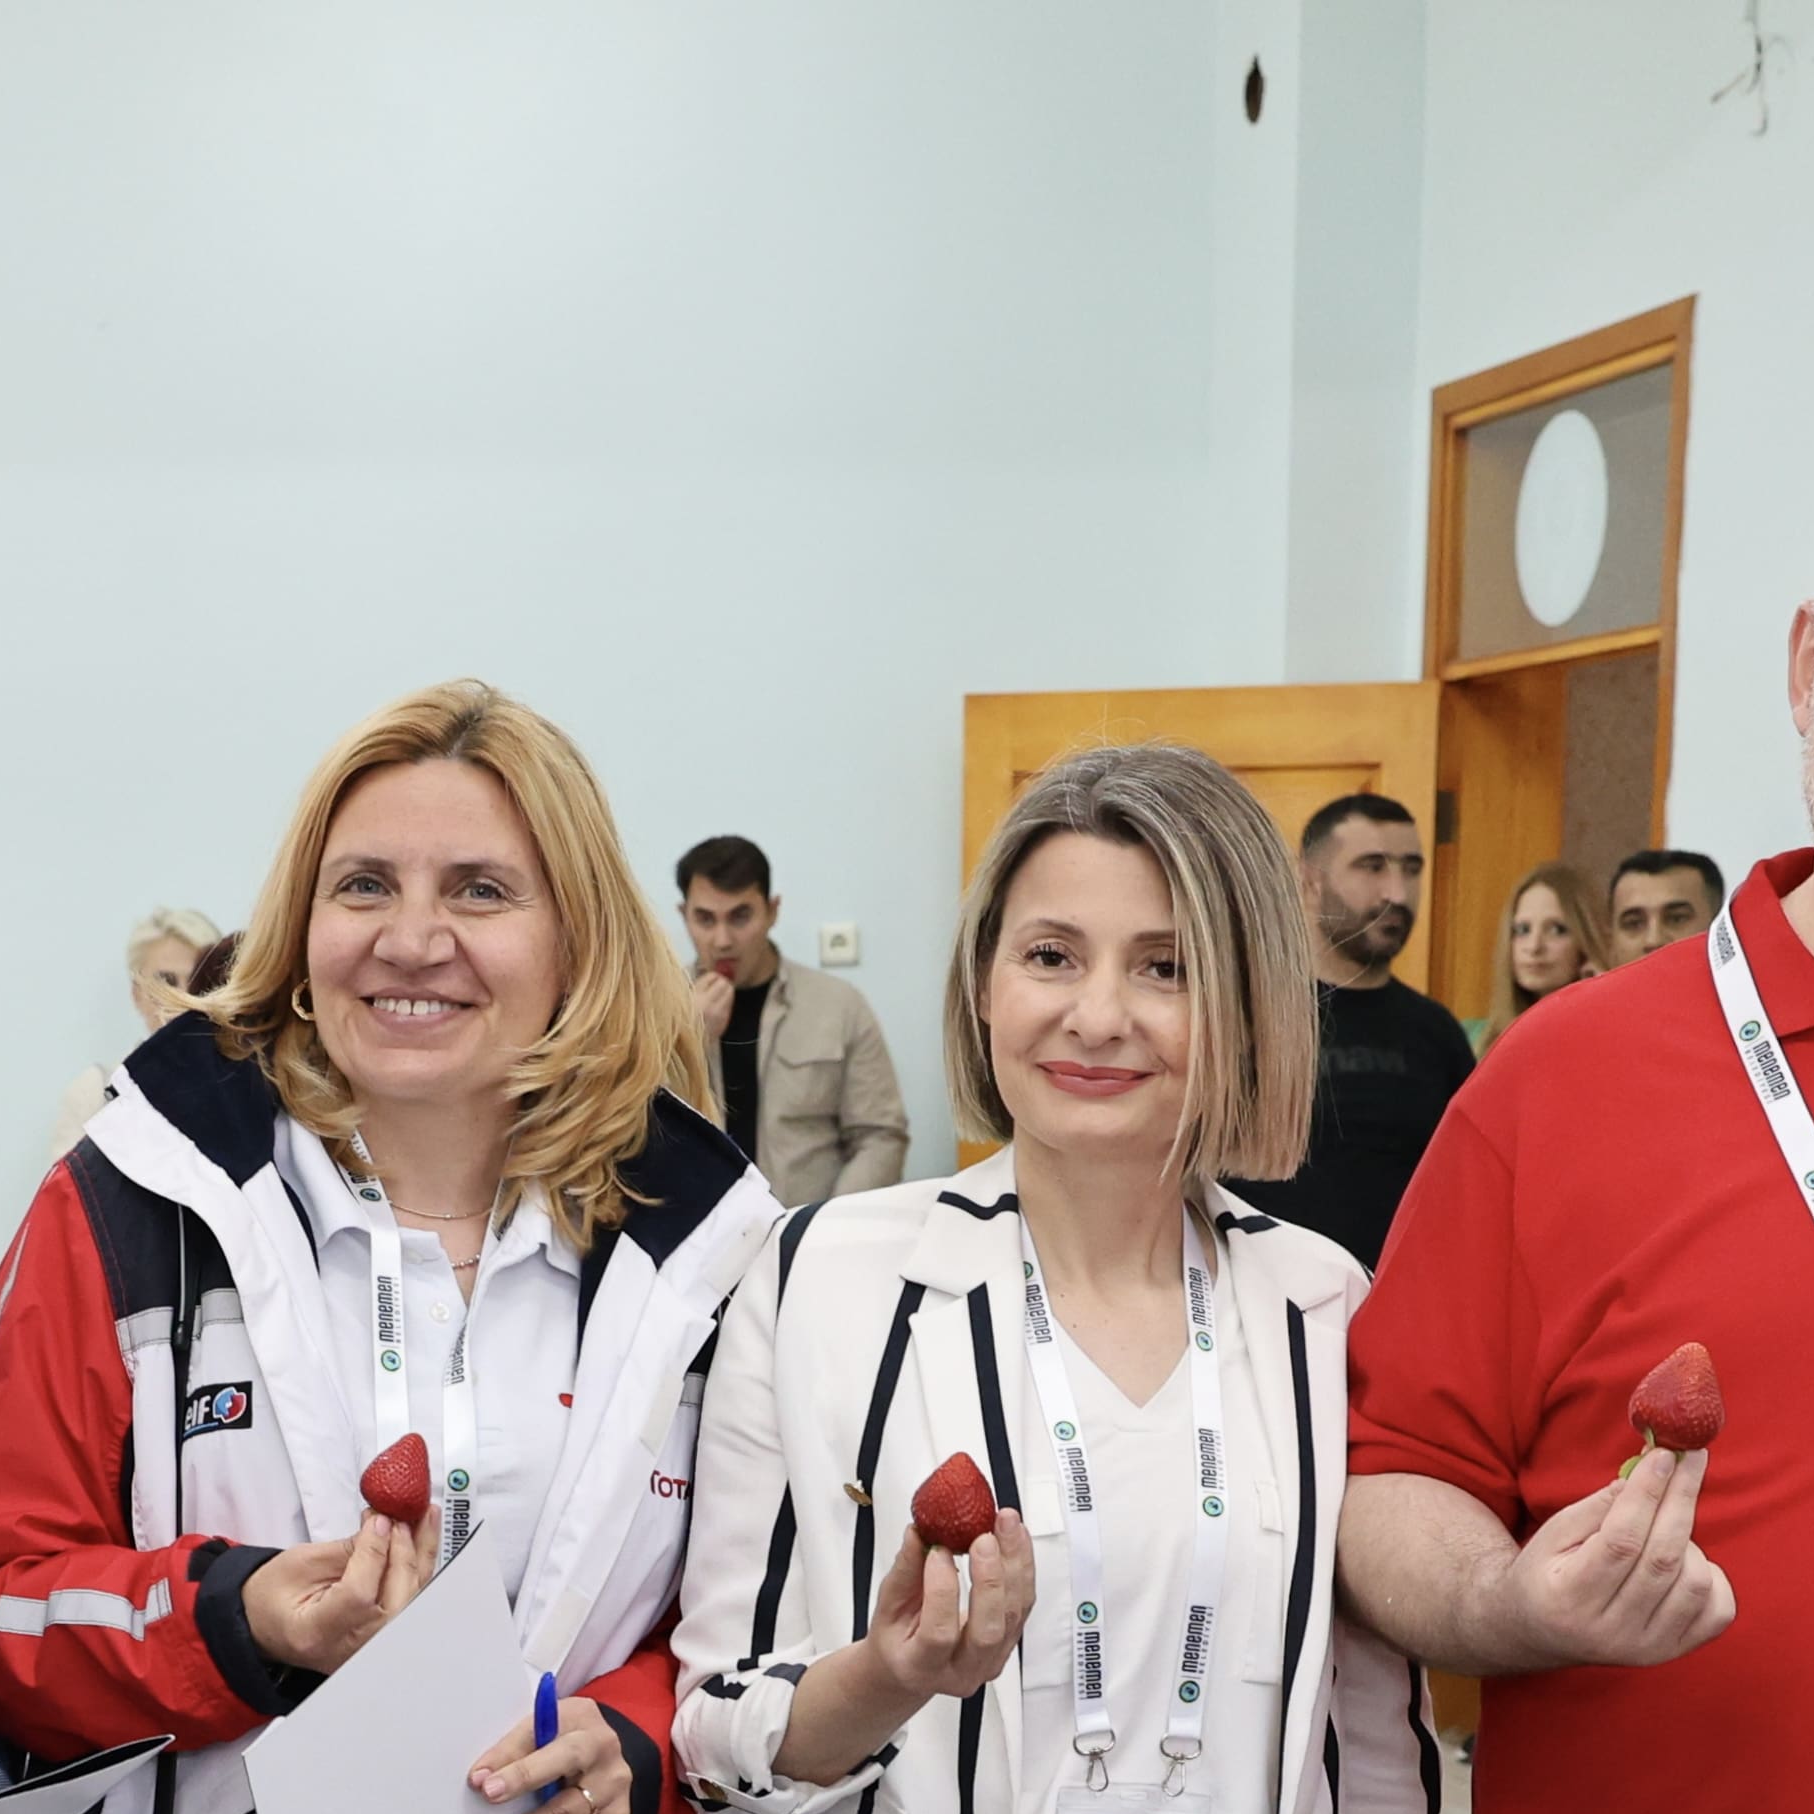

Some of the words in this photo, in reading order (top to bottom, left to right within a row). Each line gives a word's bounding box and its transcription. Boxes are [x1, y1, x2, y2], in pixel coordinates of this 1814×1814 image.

[1752, 1040, 1792, 1102] menemen
[376, 1275, 395, 1343] menemen
[1025, 1283, 1053, 1344] menemen
[1188, 1266, 1207, 1326] menemen
[1065, 1447, 1093, 1513] menemen
[1198, 1427, 1217, 1489] menemen
[1083, 1631, 1103, 1700] menemen
[1181, 1605, 1208, 1674] menemen
